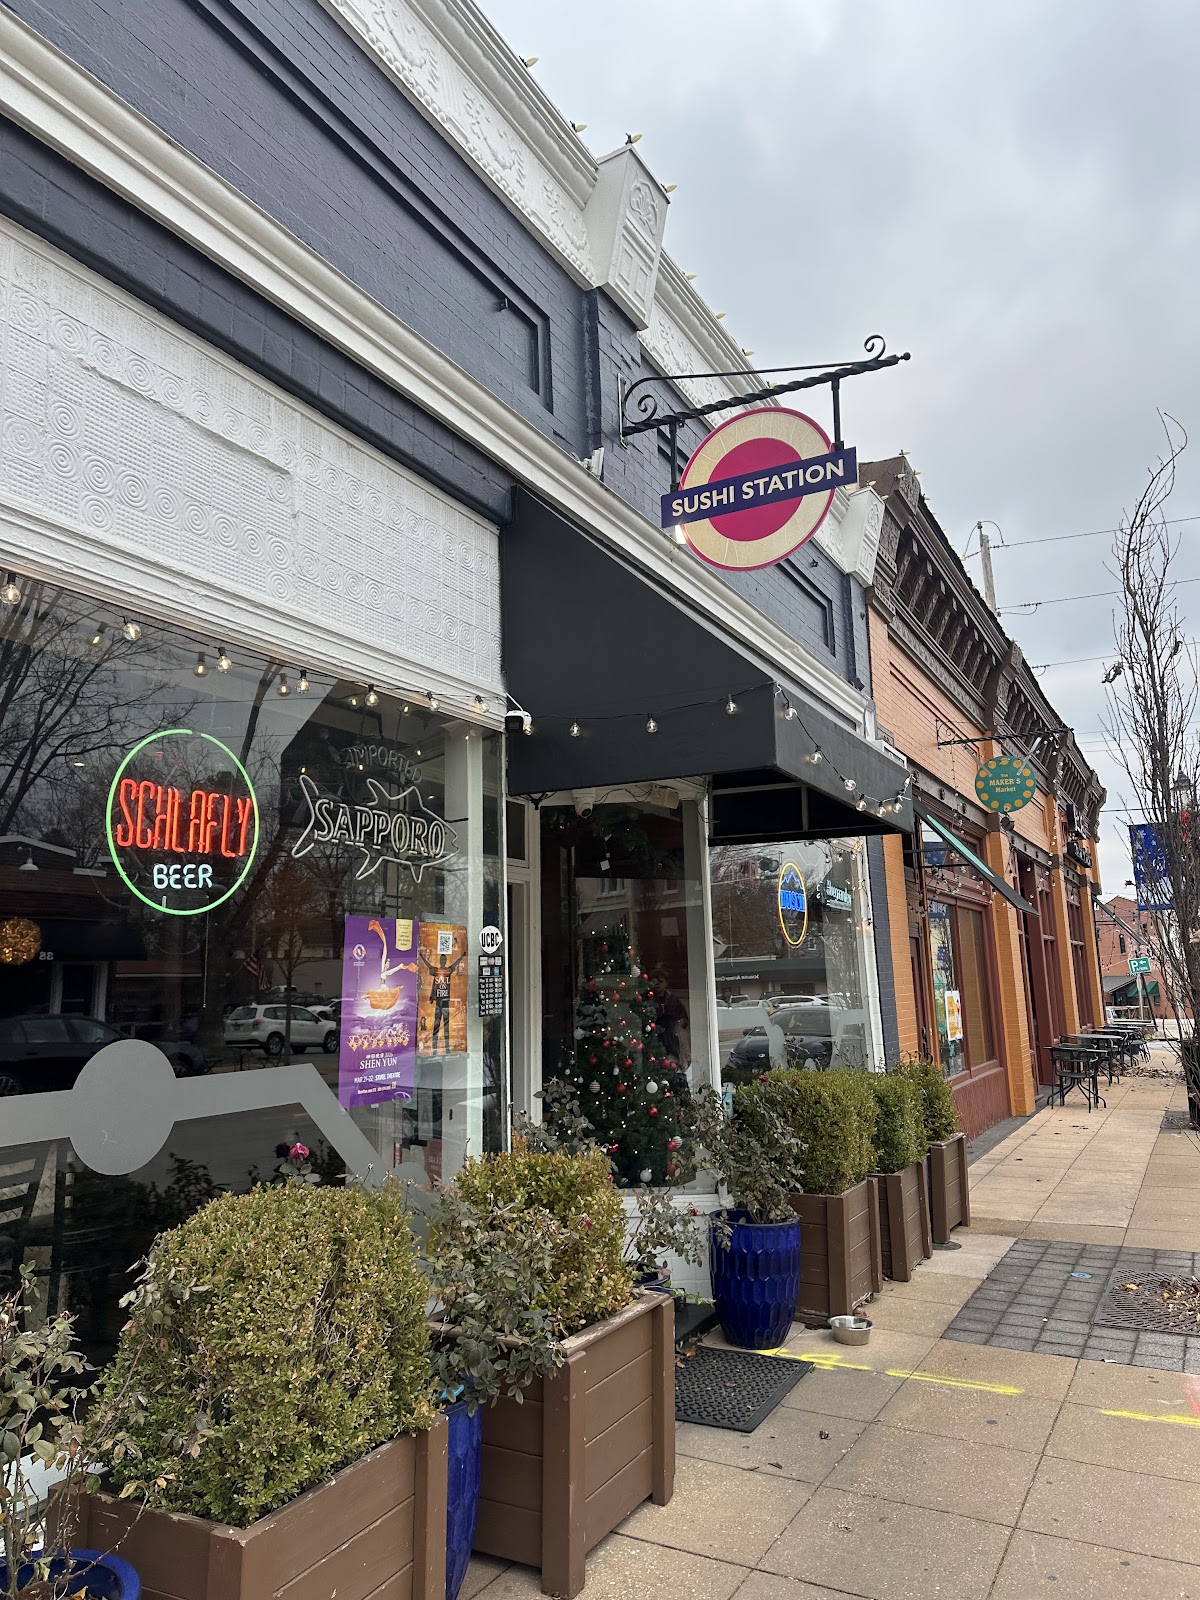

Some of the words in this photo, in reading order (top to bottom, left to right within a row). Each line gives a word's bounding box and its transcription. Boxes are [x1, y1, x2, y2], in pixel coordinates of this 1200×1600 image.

[671, 485, 736, 517] SUSHI
[742, 458, 845, 500] STATION
[989, 777, 1021, 787] MAKER'S
[115, 778, 252, 858] SCHLAFLY
[313, 797, 446, 859] SAPPORO
[153, 863, 213, 889] BEER
[481, 932, 500, 948] UCBC
[434, 976, 451, 985] SOUL
[436, 989, 449, 998] FIRE
[359, 1058, 381, 1070] SHEN
[382, 1057, 398, 1067] YUN
